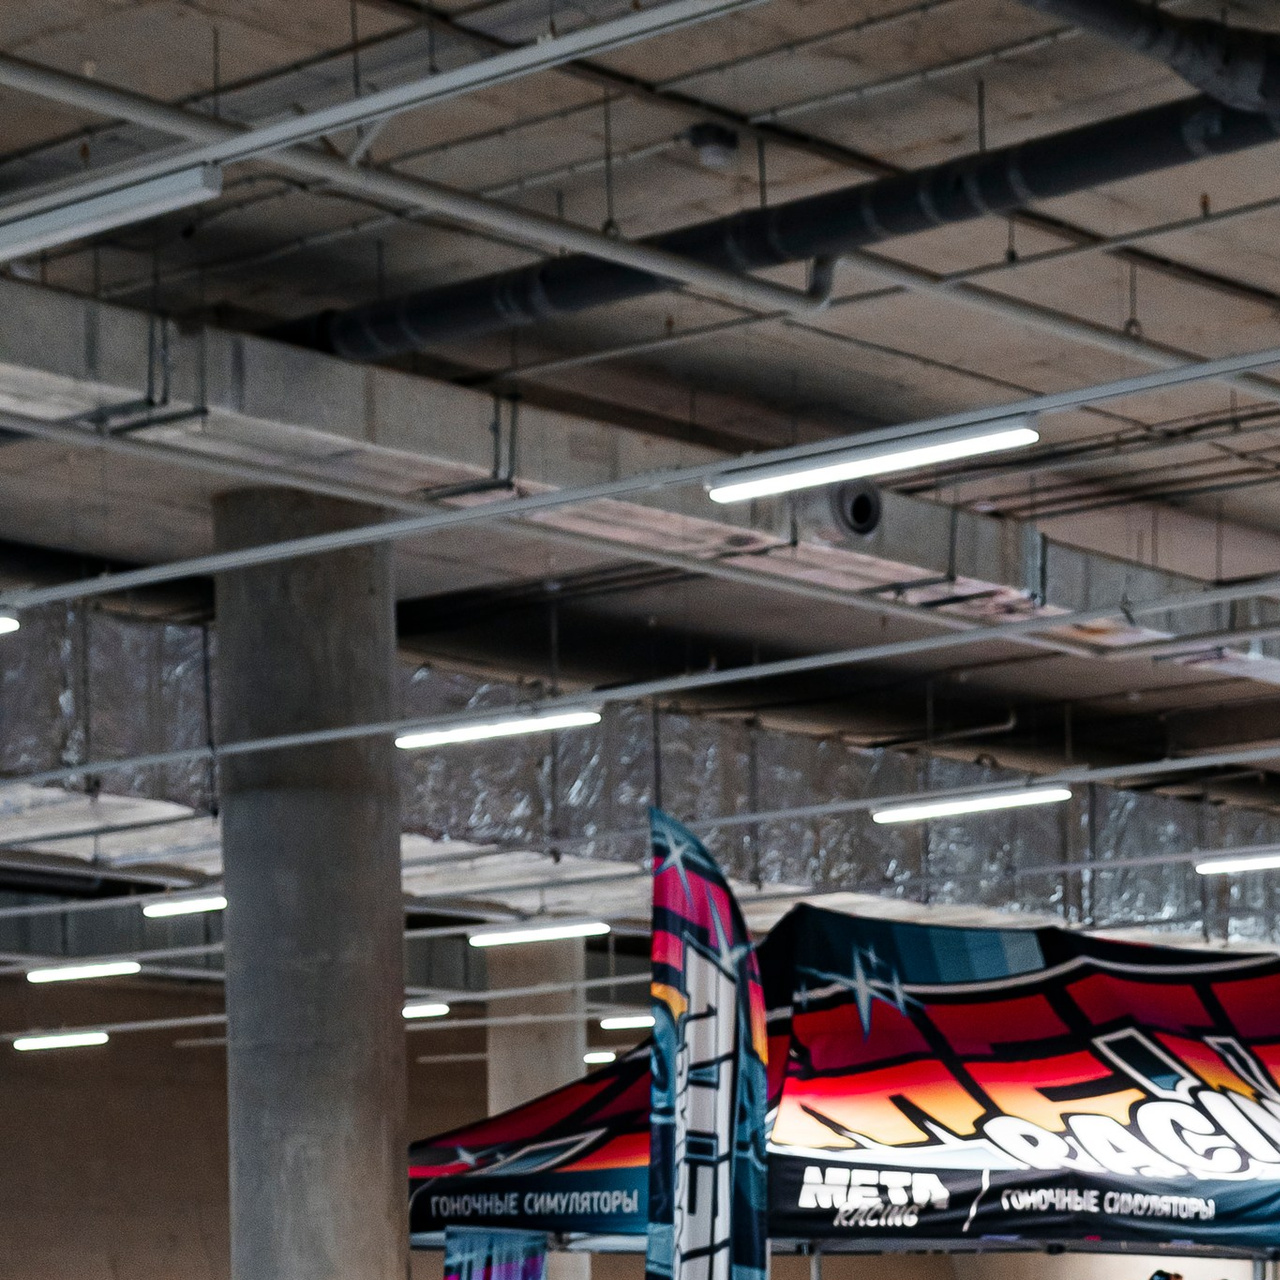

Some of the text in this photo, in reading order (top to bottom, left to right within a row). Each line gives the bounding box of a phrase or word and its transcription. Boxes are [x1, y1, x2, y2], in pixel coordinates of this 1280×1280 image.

[430, 1188, 639, 1217] ГОНОЧНЫЕ СИМУЛЯТОРЫ
[798, 1166, 950, 1210] META
[833, 1202, 919, 1228] RACING
[1001, 1188, 1216, 1221] ГОНОЧНЫЕ СИМУЛЯТОРЫ
